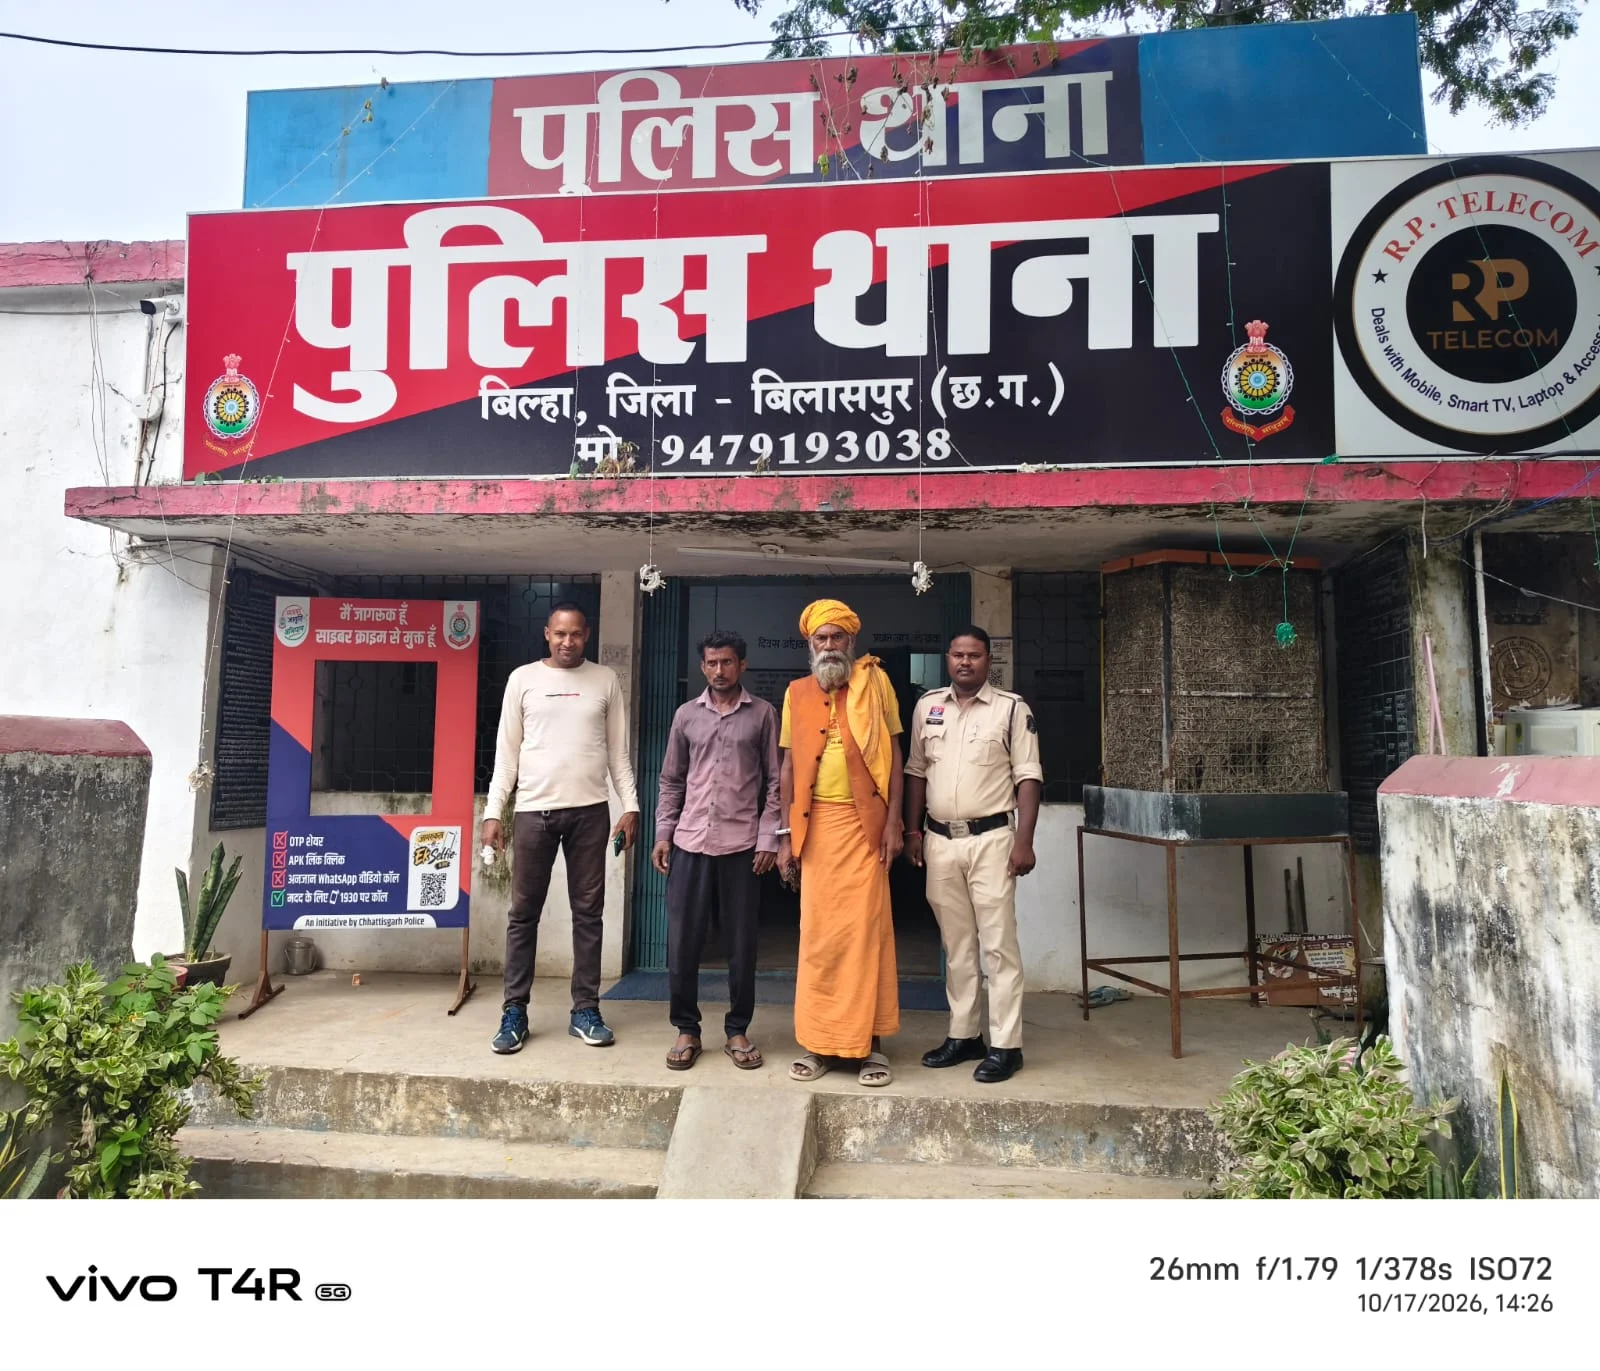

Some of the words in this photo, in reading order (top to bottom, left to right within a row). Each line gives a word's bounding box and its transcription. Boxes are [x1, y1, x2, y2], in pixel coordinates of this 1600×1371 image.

[513, 70, 820, 195] पलिस
[860, 71, 1113, 166] थाना
[1383, 216, 1437, 263] R.P.
[1437, 190, 1600, 259] TELECOM
[1452, 258, 1530, 321] RP
[286, 206, 767, 422] पुलिस
[812, 213, 1219, 356] थाना
[1426, 328, 1559, 349] TELECOM
[1371, 307, 1390, 344] Deals
[1383, 344, 1405, 372] with
[1401, 367, 1443, 405] Mobile,
[1447, 394, 1488, 412] Smart
[1492, 398, 1515, 413] TV,
[1520, 381, 1565, 409] Laptop
[1562, 371, 1577, 385] &
[478, 375, 588, 426] बिल्हा,
[606, 372, 697, 418] जिला
[751, 368, 914, 425] बिलासपुर
[931, 361, 1065, 419] (छ.ग.)
[661, 428, 951, 466] 9479193038
[339, 602, 353, 621] मैं
[353, 607, 397, 622] जागरूक
[398, 601, 408, 625] हूँ
[315, 629, 353, 645] साइबर
[354, 630, 387, 645] क्राइम
[389, 626, 401, 644] से
[403, 630, 425, 649] मुक्त
[427, 624, 437, 648] हूँ
[289, 836, 304, 846] OTP
[306, 834, 324, 846] शेयर
[288, 855, 304, 865] APK
[324, 852, 346, 865] क्लिक
[414, 846, 431, 866] Ek
[428, 847, 457, 864] Selfie
[288, 874, 317, 884] अनजान
[318, 873, 357, 885] WhatsApp
[358, 870, 381, 884] वीडियो
[383, 870, 400, 883] कॉल
[287, 893, 304, 903] मदद
[304, 890, 312, 903] के
[313, 890, 329, 903] लिए
[340, 892, 358, 903] 1930
[359, 892, 370, 903] पर
[371, 890, 388, 903] कॉल
[305, 918, 315, 927] An
[348, 918, 357, 928] by
[358, 918, 402, 927] Chhattisgarh
[404, 917, 425, 926] Police
